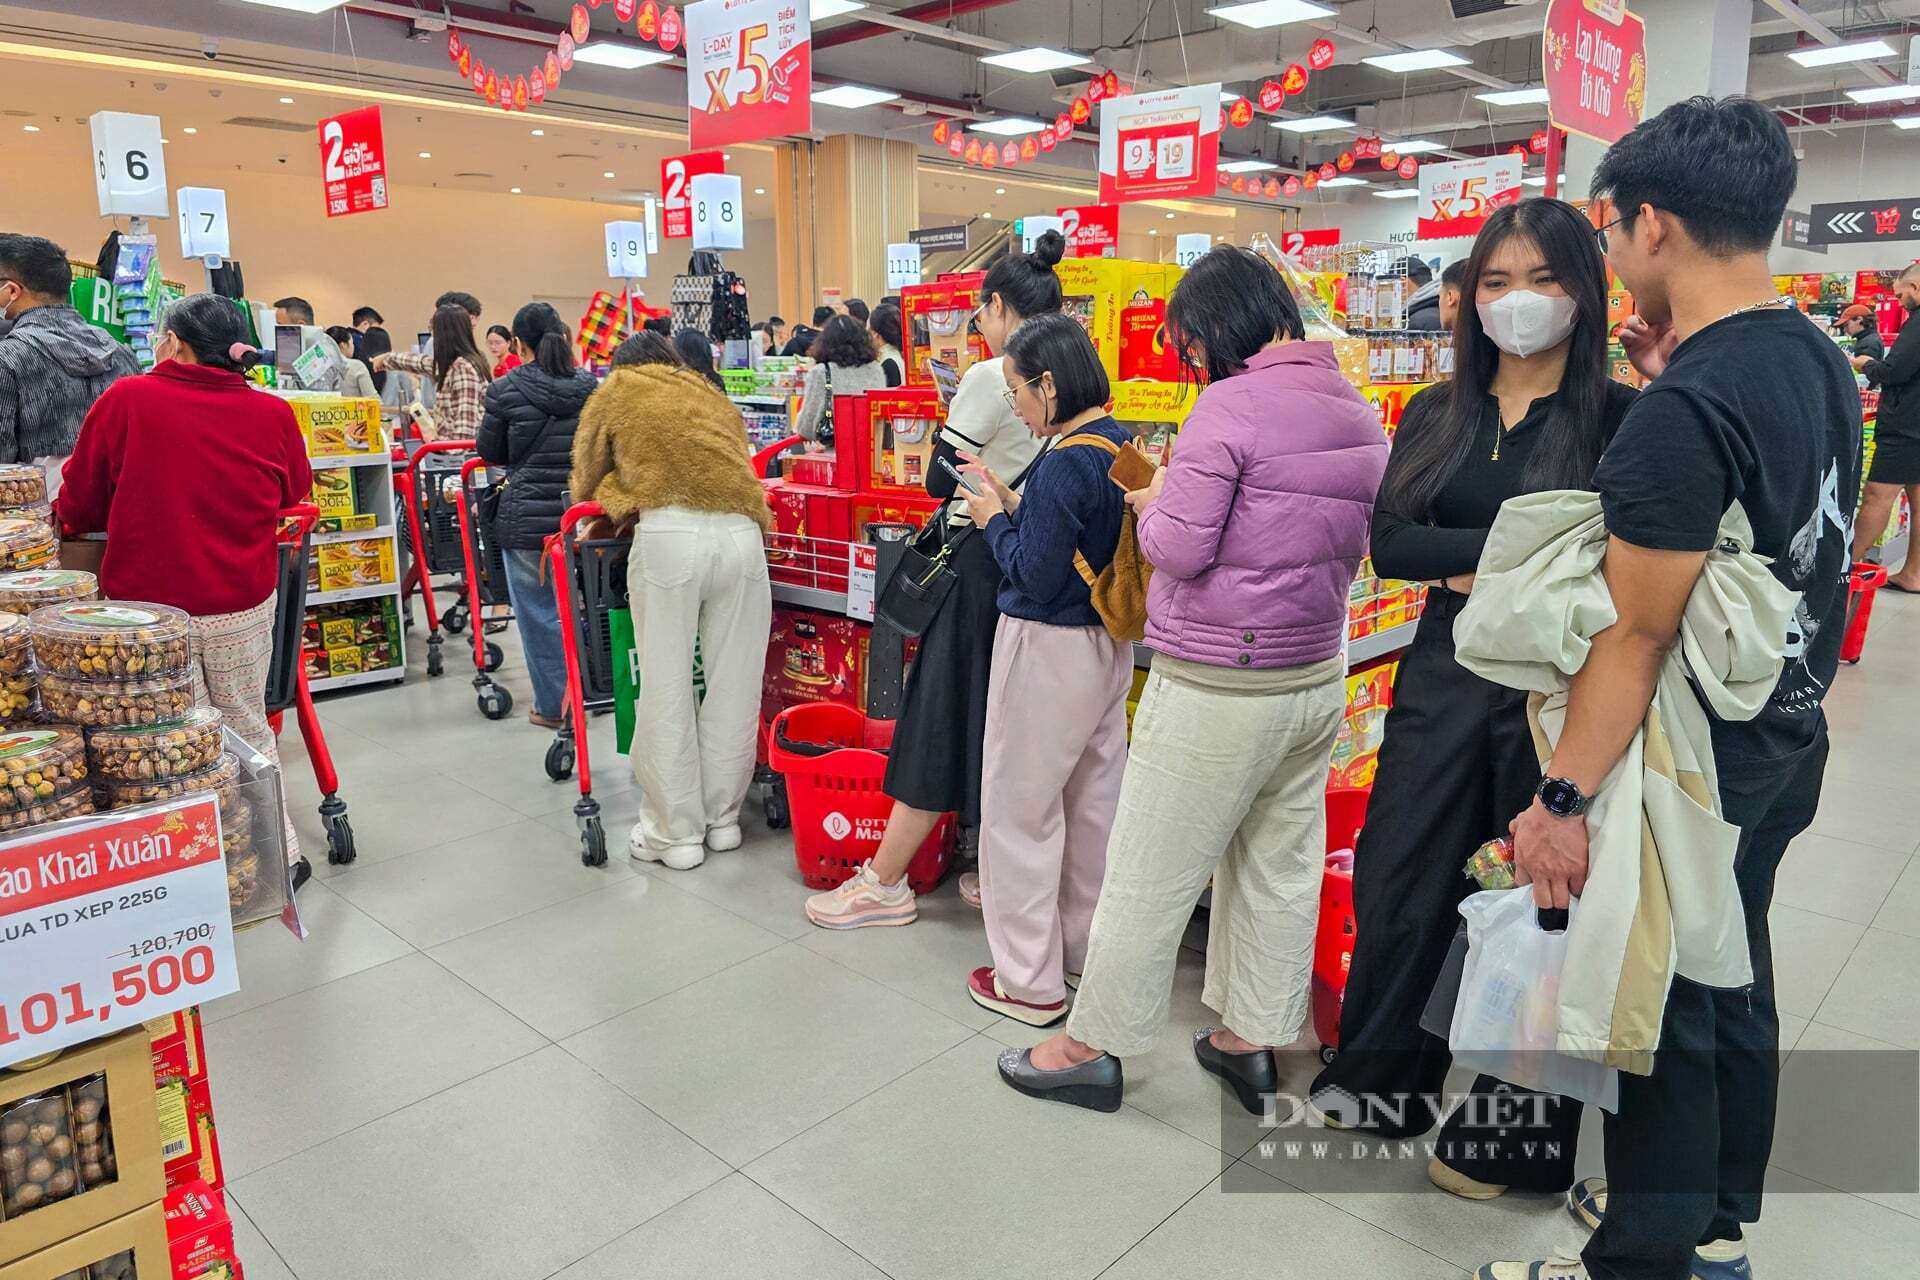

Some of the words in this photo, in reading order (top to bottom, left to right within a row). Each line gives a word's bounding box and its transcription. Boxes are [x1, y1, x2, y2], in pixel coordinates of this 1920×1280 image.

[778, 24, 795, 36] TÍCH
[704, 36, 732, 54] L-DAY
[1575, 19, 1592, 68] Lạp
[1593, 28, 1622, 84] Xưởng
[1593, 75, 1611, 117] Khô
[324, 120, 345, 182] 2
[1131, 145, 1143, 165] 9
[1163, 142, 1184, 165] 19
[126, 150, 149, 181] 6
[665, 159, 686, 210] 2
[1432, 182, 1456, 191] L-DAY
[200, 212, 215, 233] 7
[699, 201, 706, 222] 8
[721, 201, 733, 222] 8
[1062, 209, 1080, 246] 2
[1389, 229, 1418, 243] HƯỚ
[628, 240, 637, 257] 9
[1025, 237, 1031, 253] 1
[1287, 233, 1306, 264] 2
[92, 277, 124, 326] RE
[1129, 299, 1153, 307] MEIZAN
[1131, 314, 1157, 322] MEIZAN
[311, 409, 363, 421] CHOCOLAT
[855, 818, 889, 827] LOTT
[38, 843, 98, 888] Khai
[104, 833, 172, 872] Xuân
[40, 912, 69, 930] TD
[74, 900, 114, 923] XEP
[118, 886, 168, 911] 225G
[129, 922, 211, 959] 120,700
[156, 1065, 182, 1077] SINS
[184, 1192, 207, 1220] RAISINS
[178, 1246, 225, 1271] RAISINS
